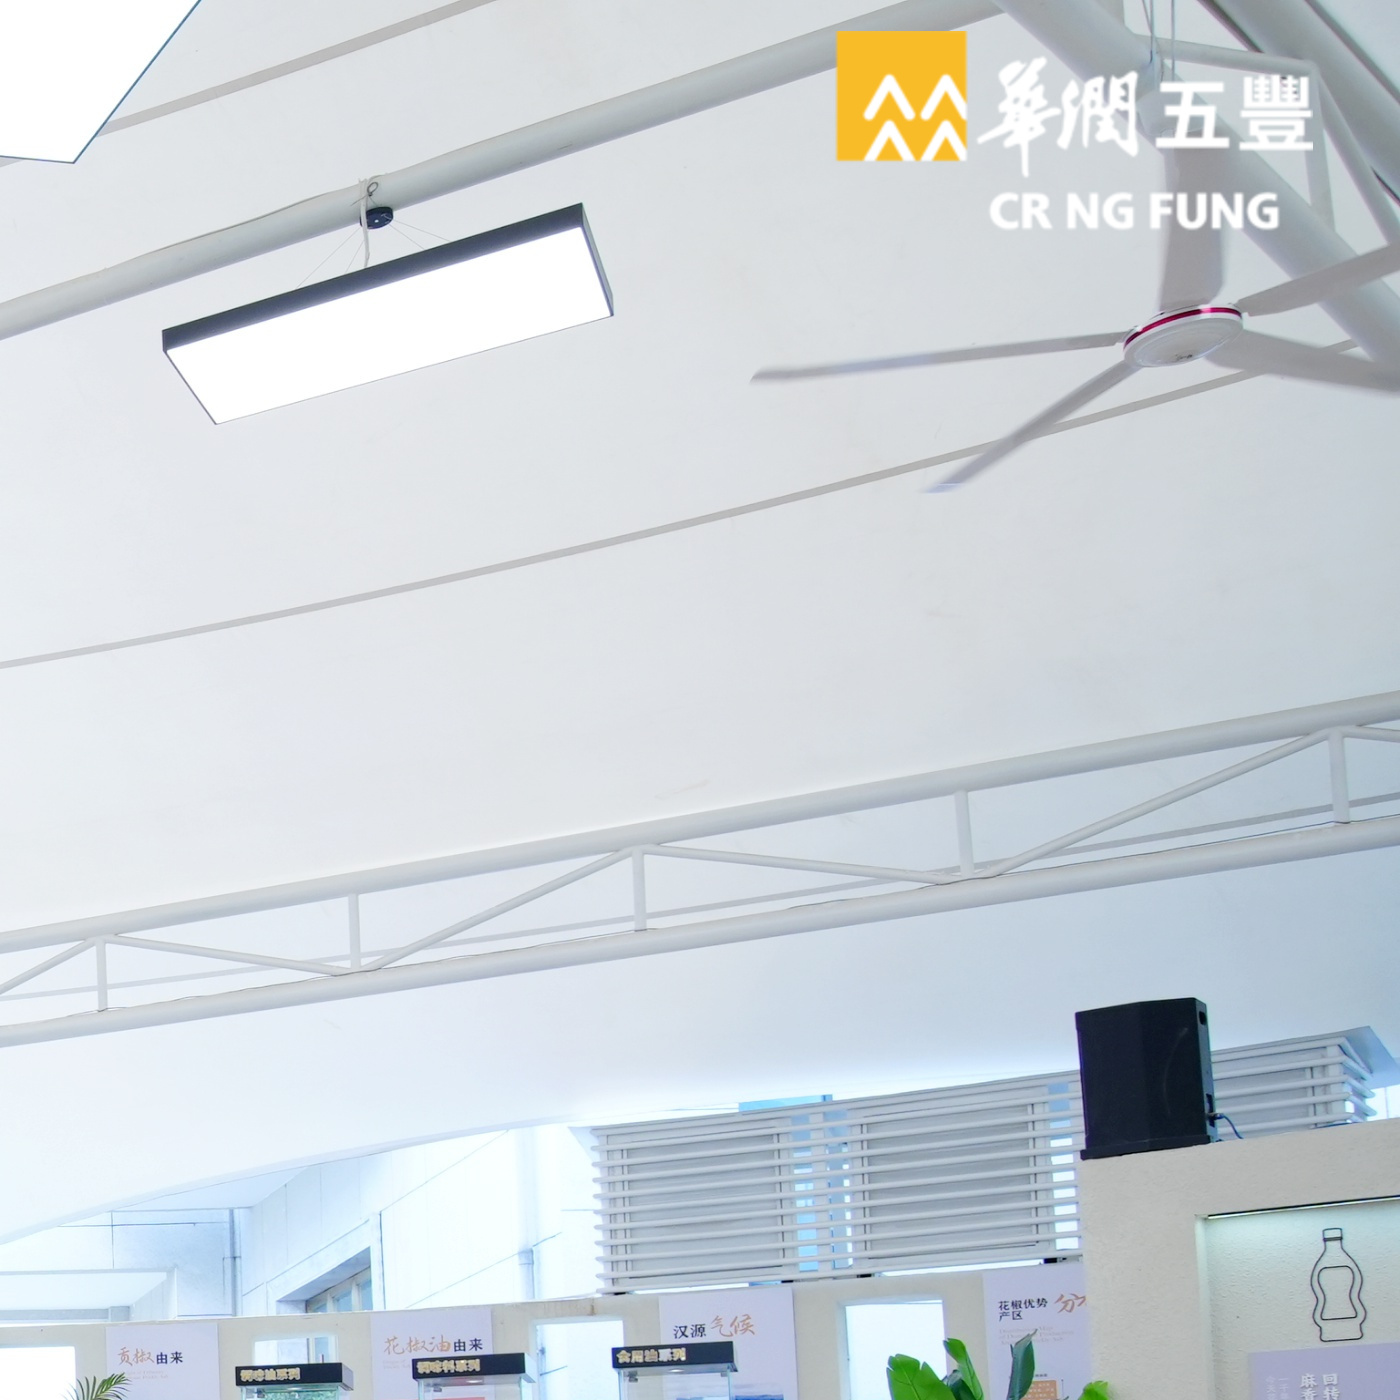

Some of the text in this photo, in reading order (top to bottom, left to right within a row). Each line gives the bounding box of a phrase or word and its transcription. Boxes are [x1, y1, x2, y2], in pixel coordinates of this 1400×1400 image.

[998, 1298, 1048, 1311] 花椒优势
[999, 1310, 1023, 1322] 产区
[673, 1314, 755, 1339] 汉源气候
[384, 1334, 483, 1356] 花椒油由来
[116, 1346, 184, 1366] 贡椒由来
